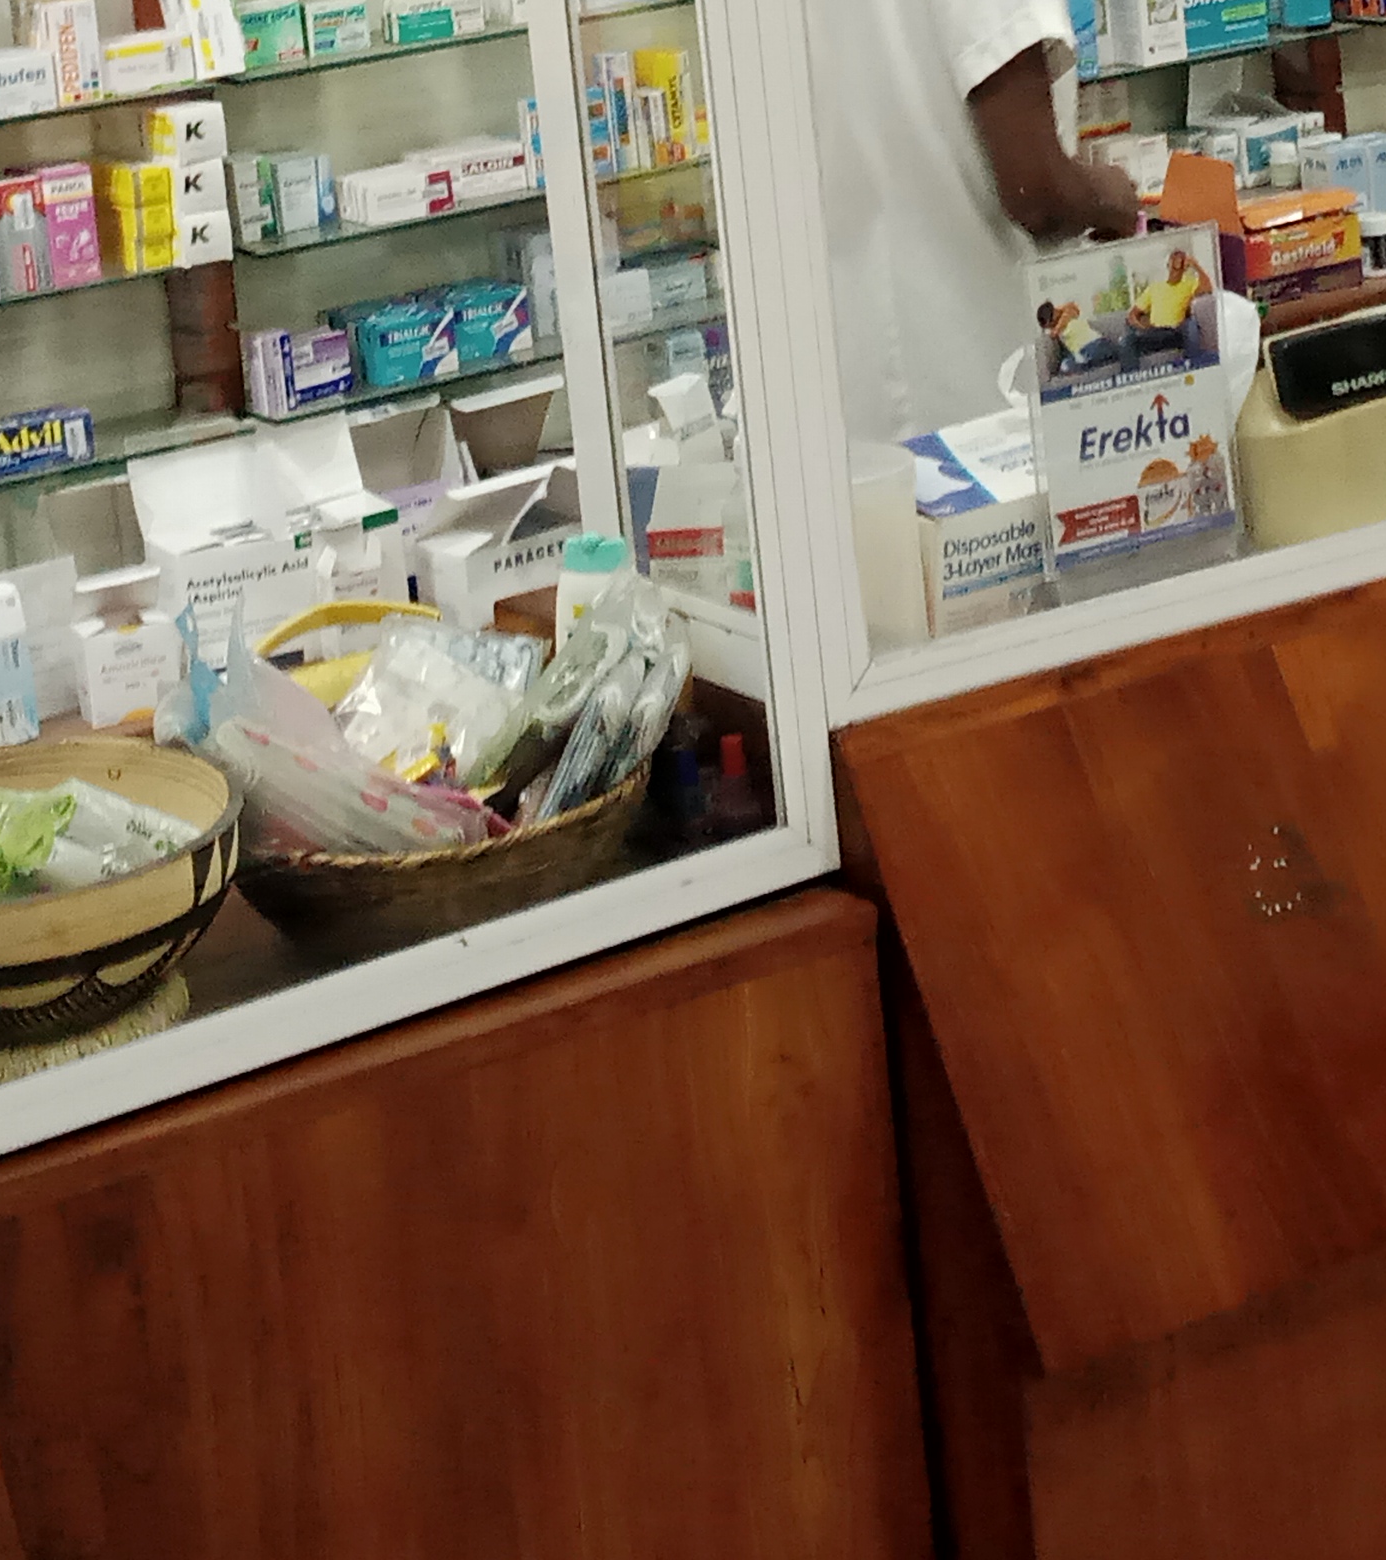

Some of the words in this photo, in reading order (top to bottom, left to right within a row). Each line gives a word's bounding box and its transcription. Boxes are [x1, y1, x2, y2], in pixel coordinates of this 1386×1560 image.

[185, 122, 205, 140] K
[184, 174, 203, 193] K
[190, 225, 210, 245] K
[1079, 410, 1190, 462] Erekta
[943, 520, 1035, 559] Disposable
[281, 557, 309, 574] Acid
[493, 542, 566, 573] PARACET
[943, 551, 1002, 582] 3-Layer
